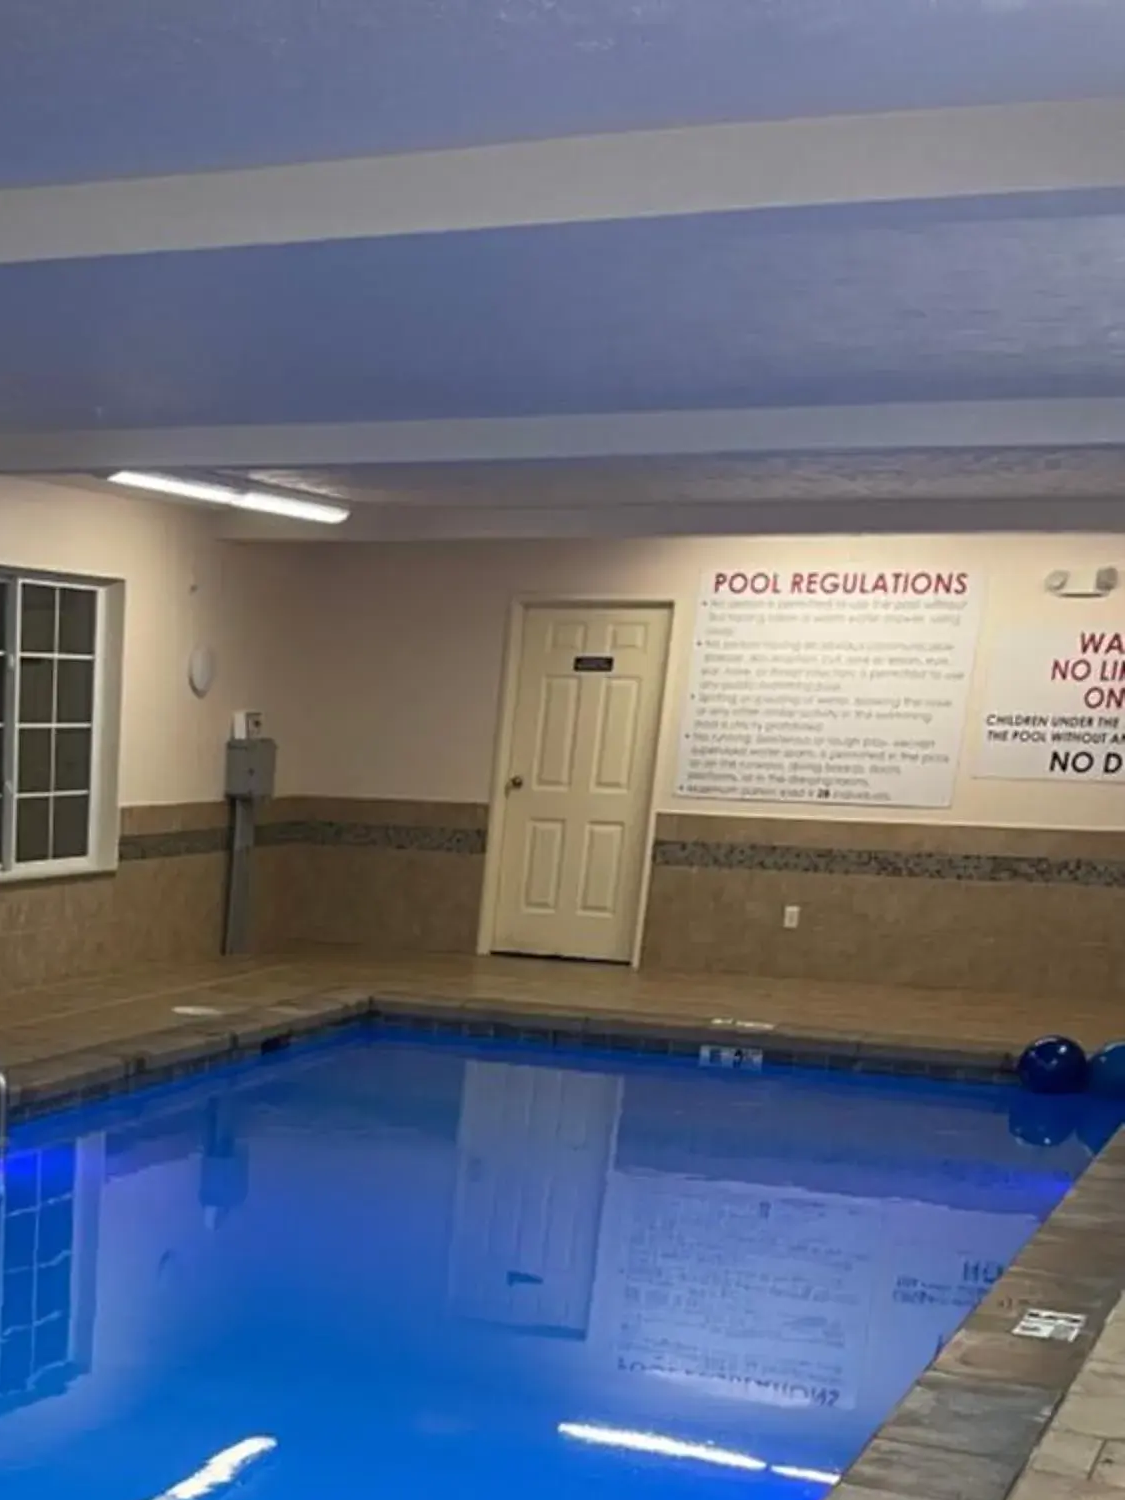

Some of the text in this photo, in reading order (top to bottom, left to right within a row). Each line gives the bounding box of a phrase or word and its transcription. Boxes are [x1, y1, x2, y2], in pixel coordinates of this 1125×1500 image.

[714, 572, 970, 595] POOL REGULATIONS
[1051, 659, 1091, 681] NO
[986, 714, 1120, 728] CHILDREN UNDER THE
[988, 730, 1008, 742] THE
[1012, 731, 1047, 742] POOL
[1051, 732, 1107, 744] WITHOUT
[1049, 751, 1094, 773] NO
